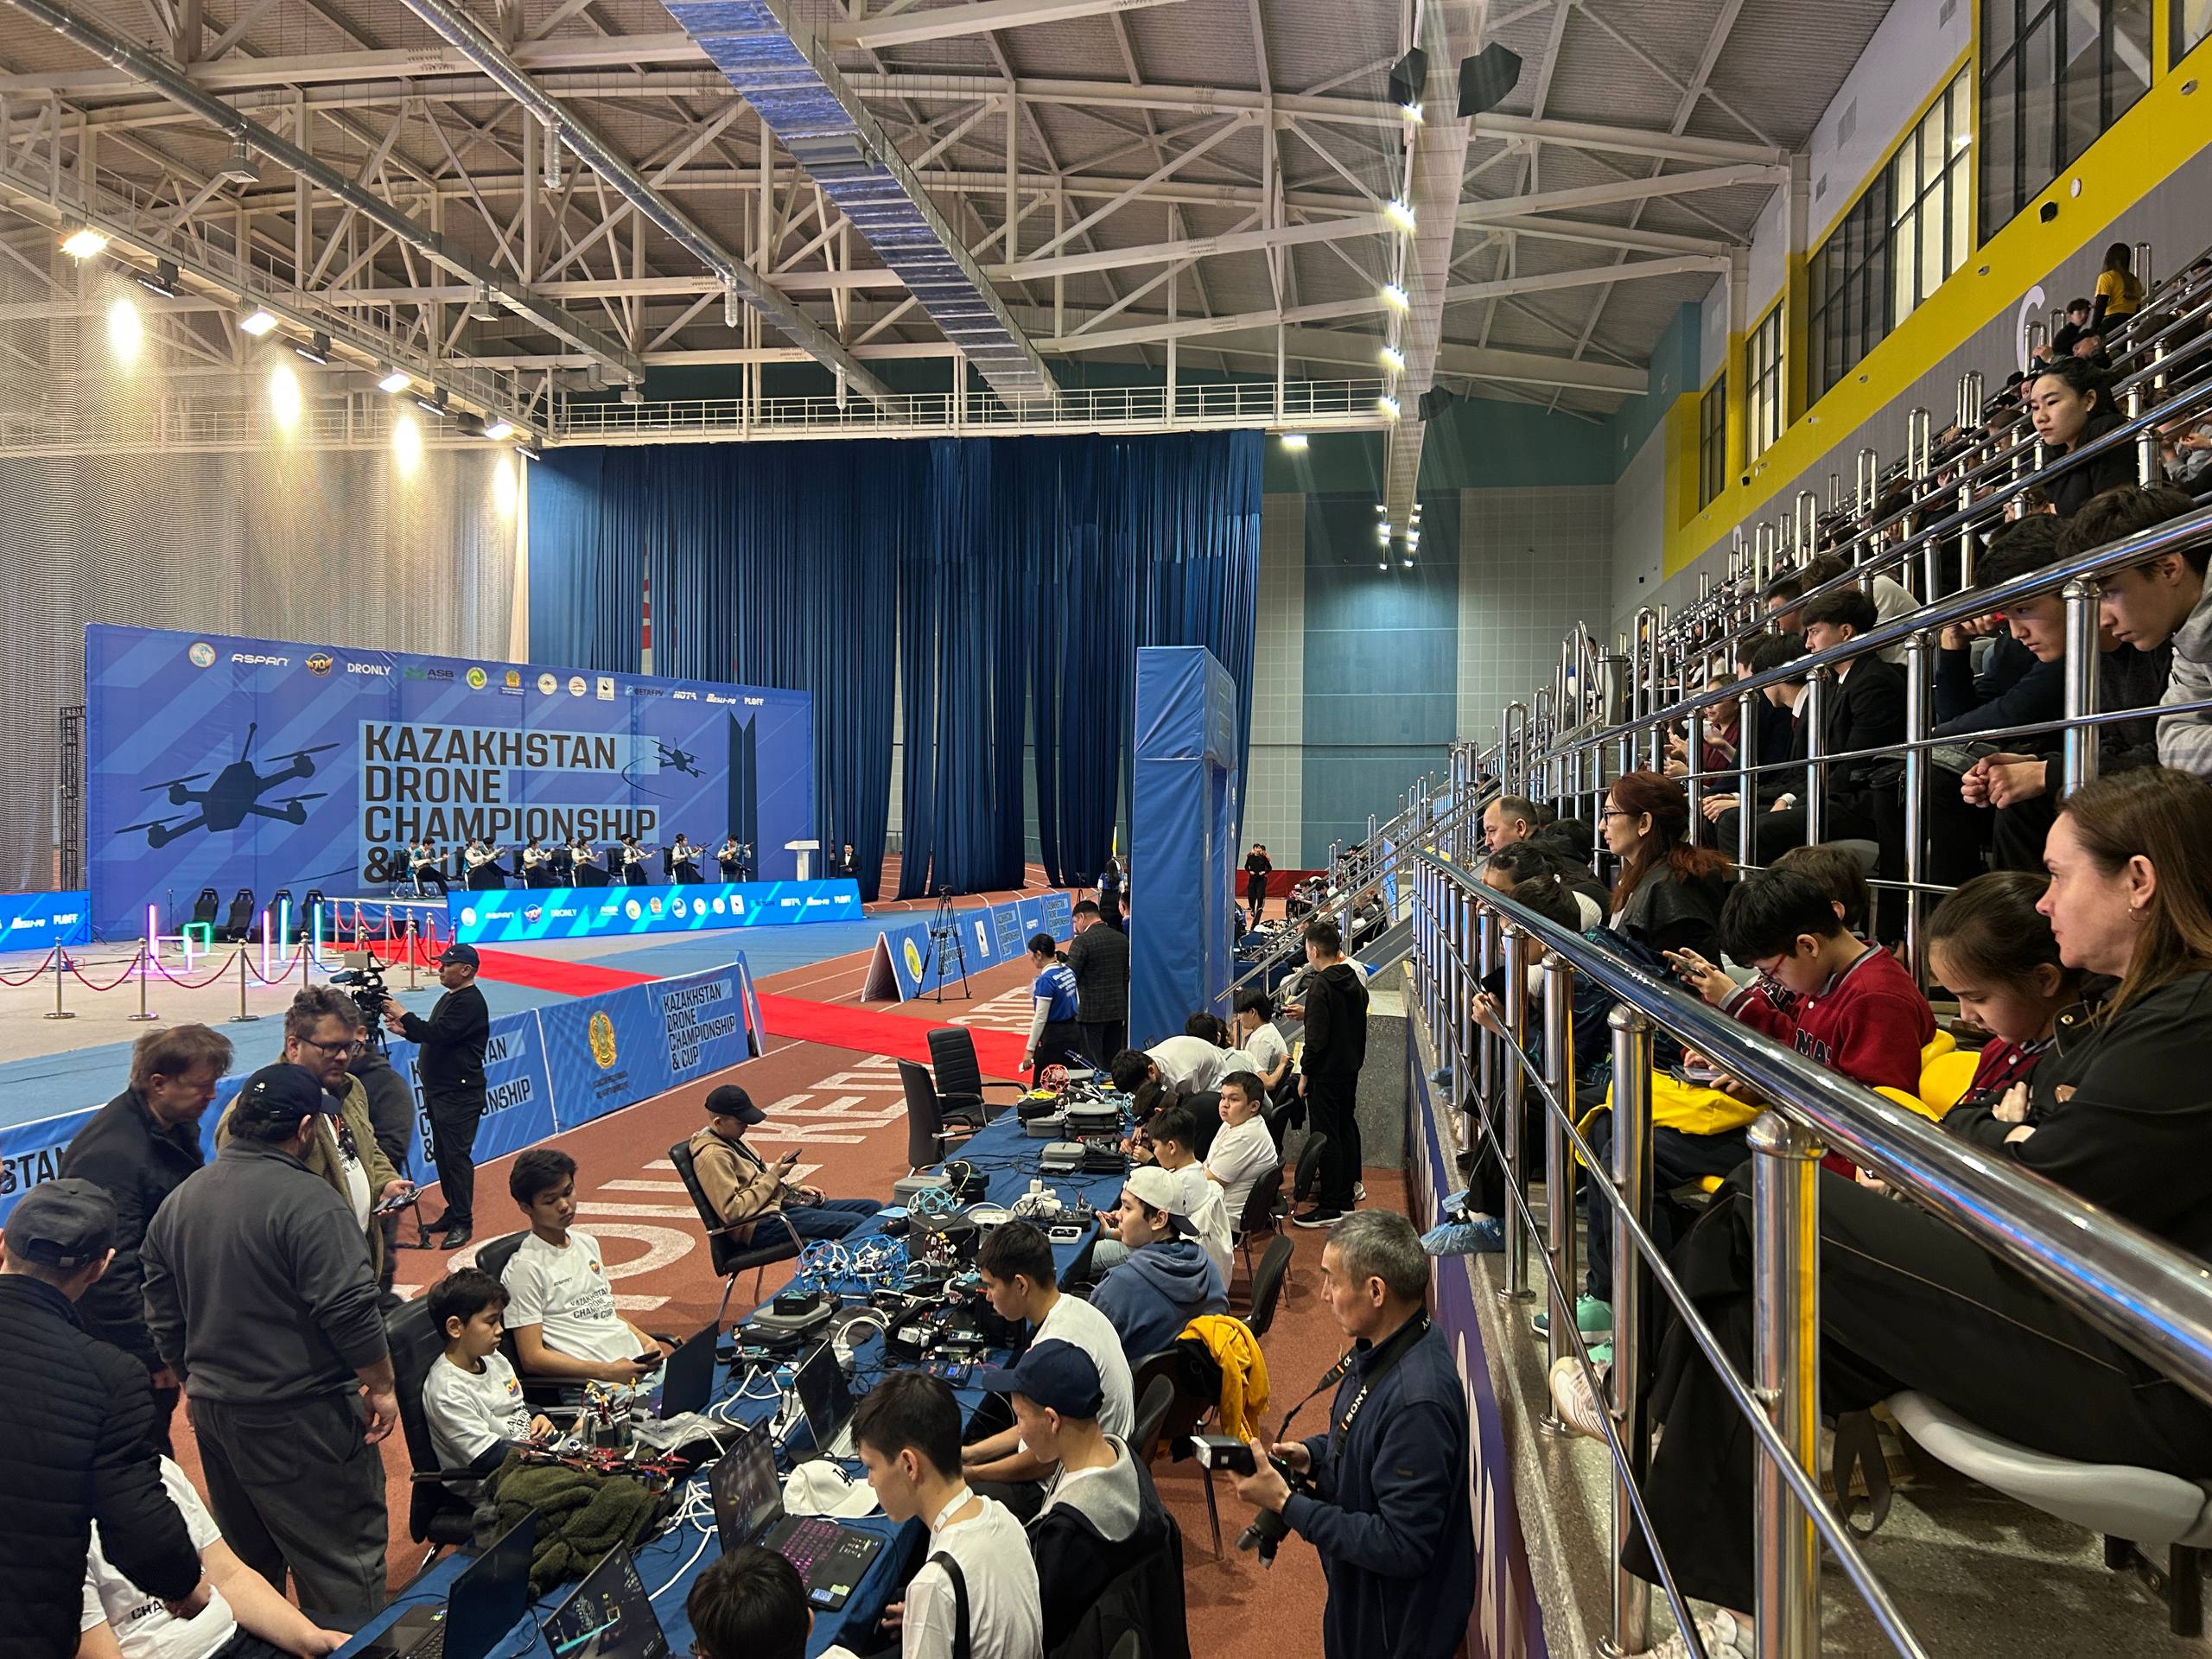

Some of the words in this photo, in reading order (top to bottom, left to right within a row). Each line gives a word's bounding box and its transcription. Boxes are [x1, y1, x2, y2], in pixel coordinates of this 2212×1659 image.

[347, 663, 391, 676] DRONLY
[428, 669, 454, 677] ASB
[365, 724, 616, 769] KAZAKHSTAN
[365, 766, 500, 802] DRONE
[365, 807, 656, 842] CHAMPIONSHIP
[664, 983, 721, 1014] KAZAKHSTAN
[667, 1009, 696, 1033] DRONE
[669, 1015, 736, 1052] CHAMPIONSHIP
[672, 1053, 680, 1071] &
[681, 1046, 700, 1068] CUP
[1345, 1384, 1369, 1423] SONY
